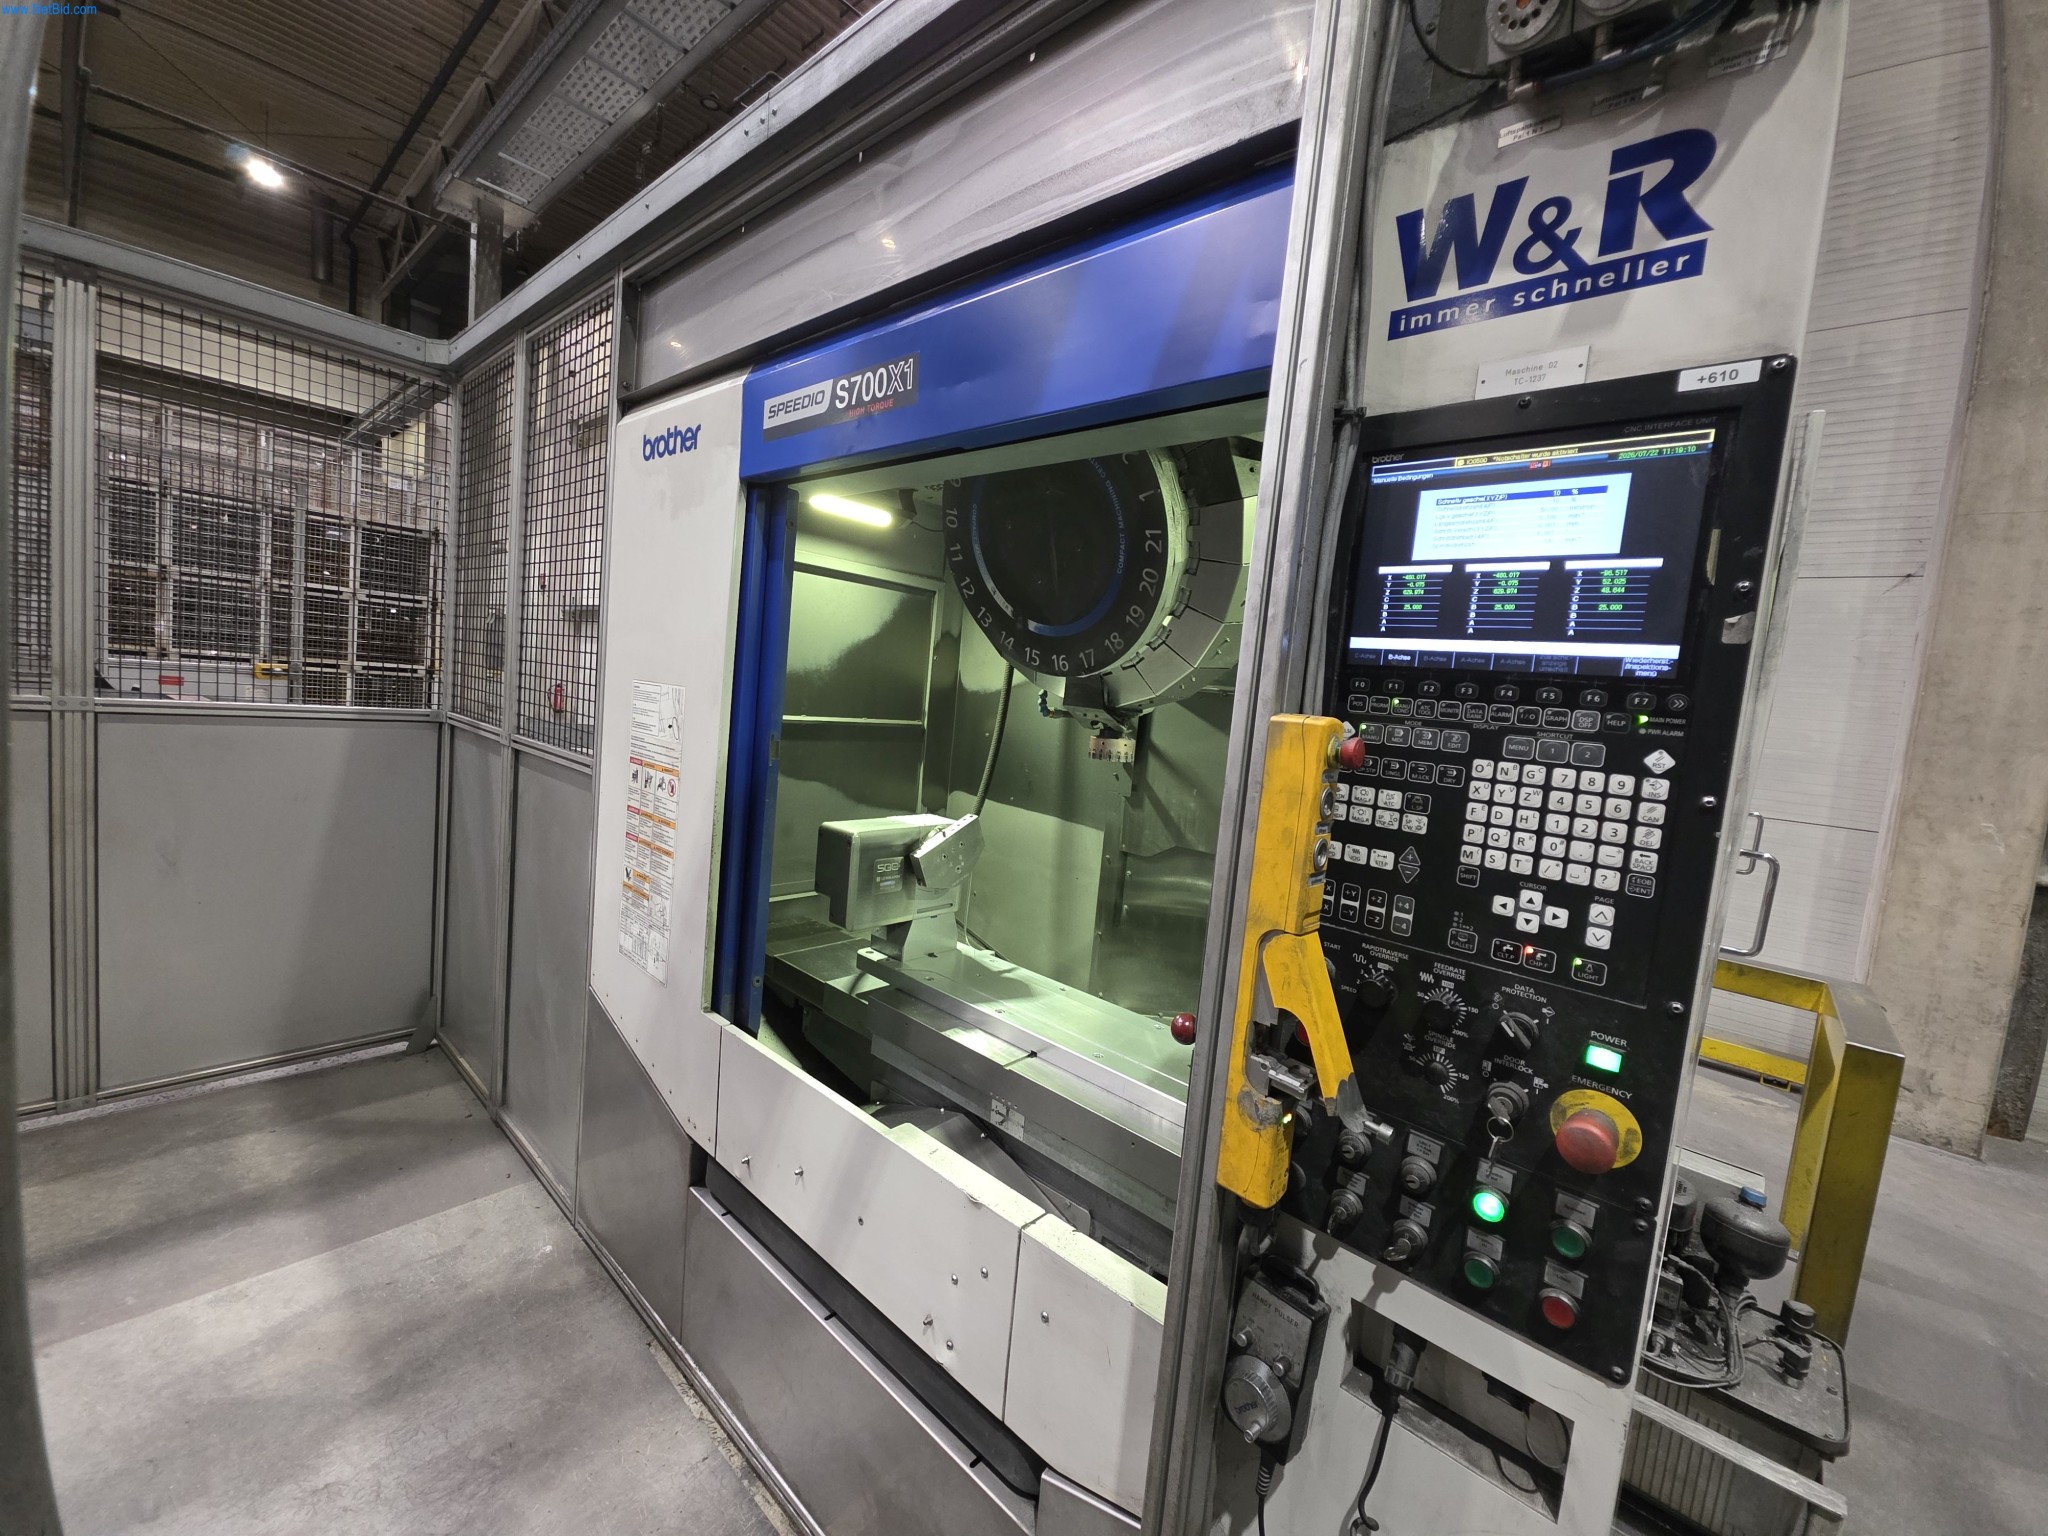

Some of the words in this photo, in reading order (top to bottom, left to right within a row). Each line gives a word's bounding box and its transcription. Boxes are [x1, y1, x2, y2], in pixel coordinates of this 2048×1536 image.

[1396, 128, 1716, 302] W&R
[1399, 297, 1496, 331] immer
[1513, 253, 1691, 307] schneller
[1505, 363, 1545, 376] Maschine
[1514, 373, 1546, 385] TC-1237
[1697, 369, 1739, 384] +610
[768, 389, 826, 419] SPEEDIO
[835, 358, 913, 409] S700X1
[849, 406, 865, 417] HIGH
[867, 399, 894, 414] TORQUE
[1624, 425, 1642, 433] CNC
[1644, 420, 1693, 430] INTERFACE
[1696, 417, 1717, 425] UNIT
[643, 424, 701, 462] brother
[1531, 450, 1550, 458] wurde
[1551, 447, 1579, 456] aktiviert
[1663, 445, 1697, 455] 11:19:10
[1372, 453, 1405, 463] brother
[1398, 473, 1433, 482] Bedingungen
[1553, 489, 1561, 497] 10
[946, 507, 958, 528] 10
[1145, 528, 1162, 553] 21
[949, 543, 963, 562] 11
[1116, 533, 1126, 575] COMPACT
[960, 576, 976, 599] 12
[1139, 568, 1159, 598] 20
[976, 606, 993, 628] 13
[1126, 605, 1145, 629] 19
[999, 631, 1015, 652] 14
[1104, 631, 1125, 655] 18
[1024, 647, 1041, 666] 15
[1079, 649, 1096, 669] 17
[1052, 654, 1069, 672] 16
[1537, 731, 1574, 739] SHORTCUT
[1475, 765, 1484, 773] O
[1500, 767, 1509, 776] N
[1526, 770, 1536, 779] G
[1560, 774, 1568, 784] 7
[1587, 777, 1596, 787] 8
[1617, 780, 1625, 790] 9
[1472, 786, 1481, 794] X
[1498, 789, 1506, 798] Y
[1523, 793, 1531, 802] Z
[1556, 796, 1565, 806] 4
[1585, 800, 1593, 809] 5
[1614, 804, 1622, 813] 6
[1471, 807, 1477, 816] F
[1495, 811, 1503, 819] D
[1520, 815, 1528, 824] H
[1554, 819, 1559, 828] 1
[1468, 829, 1475, 837] P
[1581, 824, 1589, 833] 2
[1610, 828, 1618, 837] 3
[1491, 832, 1500, 843] Q
[1518, 837, 1525, 846] R
[1550, 842, 1558, 851] 0
[1639, 839, 1654, 847] DEL
[1462, 850, 1474, 859] M
[1489, 854, 1496, 863] S
[1515, 859, 1522, 868] T
[1632, 863, 1653, 871] SPACE
[1459, 872, 1477, 880] SHIFT
[1601, 875, 1608, 884] ?
[1636, 877, 1652, 885] EOB
[1519, 881, 1547, 891] CURSOR
[1594, 896, 1614, 904] PAGE
[1324, 941, 1341, 950] START
[1362, 942, 1409, 960] RAPIDTRAVERSE
[1369, 950, 1399, 963] OVERRIDE
[1434, 962, 1466, 975] FEEDRATE
[1433, 968, 1466, 981] OVERRIDE
[1577, 972, 1598, 981] LIGHT
[1341, 984, 1357, 994] SPEED
[1514, 983, 1535, 994] DATA
[1501, 986, 1547, 1003] PROTECTION
[1468, 1006, 1479, 1014] 150
[1428, 1030, 1454, 1042] SPINDLE
[1452, 1028, 1469, 1038] 200%
[1424, 1035, 1456, 1050] OVERRIDE
[1590, 1030, 1628, 1047] POWER
[1503, 1054, 1526, 1065] DOOR
[1494, 1058, 1533, 1075] INTERLOCK
[1458, 1073, 1469, 1081] 150
[1571, 1075, 1633, 1100] EMERGENCY
[1443, 1094, 1460, 1104] 200%
[1252, 1291, 1272, 1311] HANDY
[1275, 1308, 1299, 1329] PULSER
